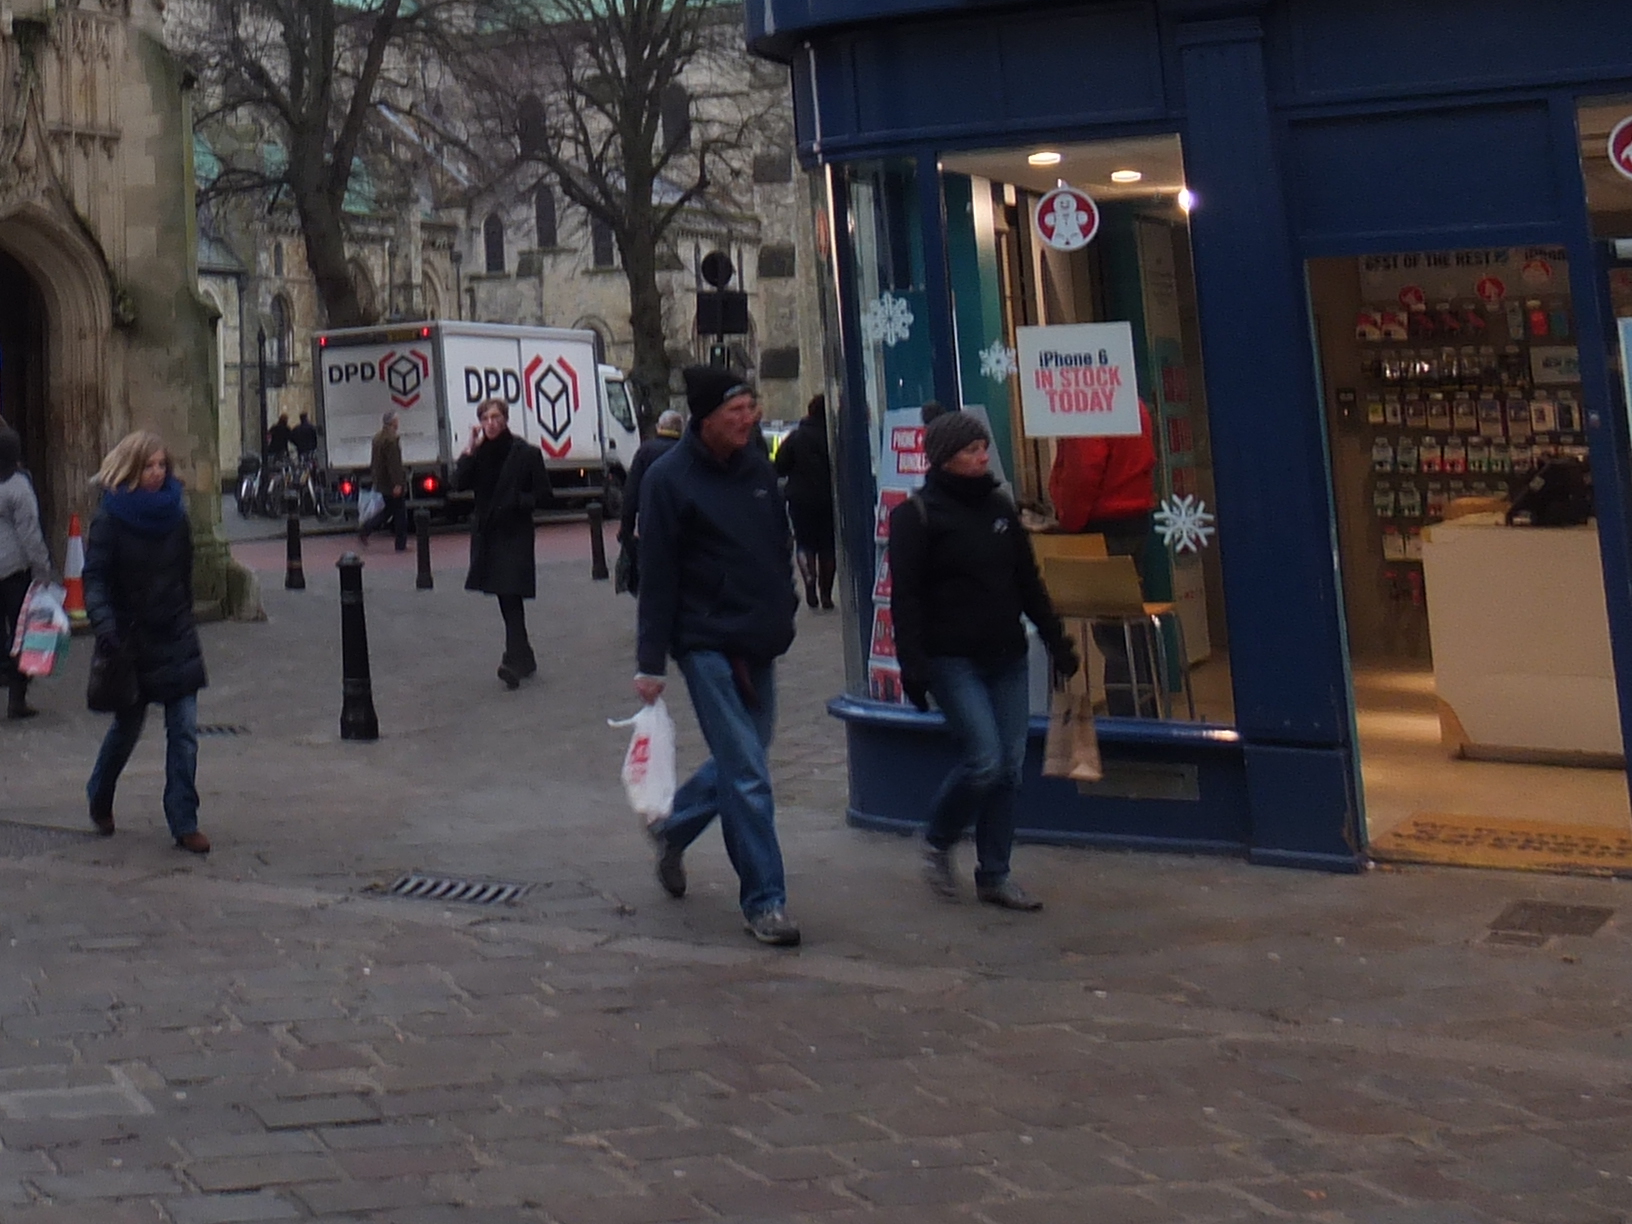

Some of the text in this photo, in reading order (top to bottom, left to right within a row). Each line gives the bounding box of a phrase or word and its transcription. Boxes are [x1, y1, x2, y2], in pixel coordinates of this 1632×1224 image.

[1039, 348, 1109, 368] iPhone 6
[328, 362, 376, 384] DPD
[463, 366, 521, 404] DPD
[1034, 365, 1122, 390] IN STOCK
[1045, 387, 1116, 413] TODAY
